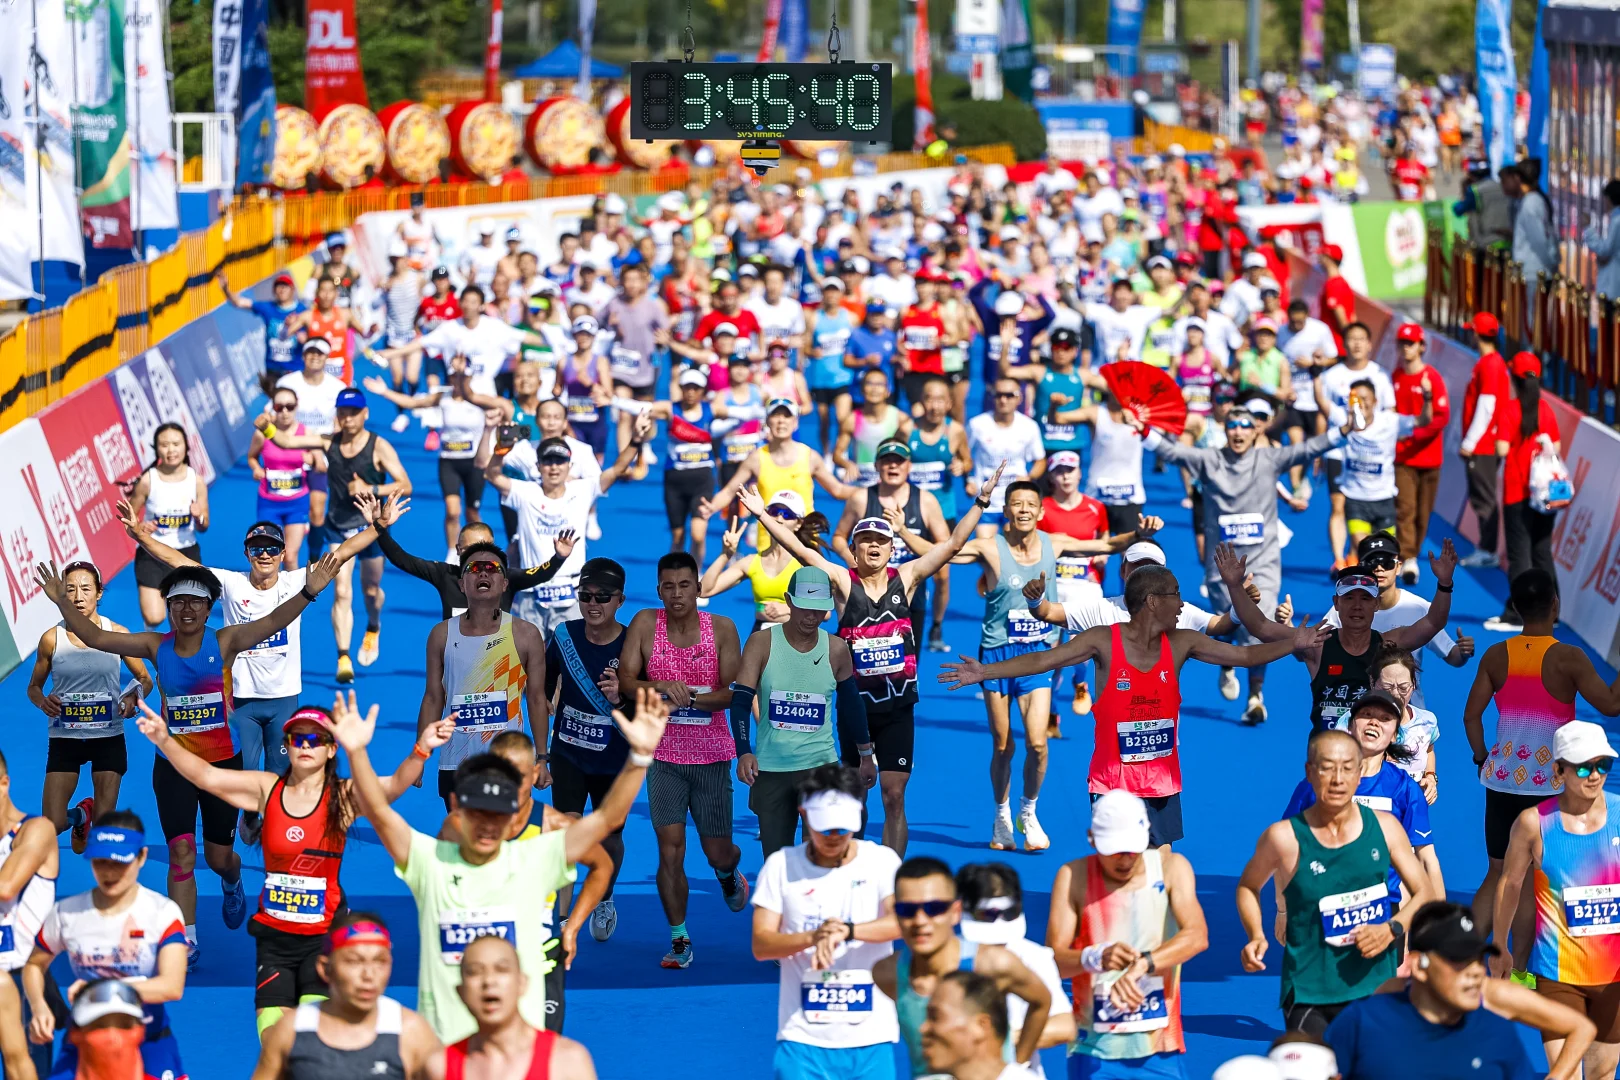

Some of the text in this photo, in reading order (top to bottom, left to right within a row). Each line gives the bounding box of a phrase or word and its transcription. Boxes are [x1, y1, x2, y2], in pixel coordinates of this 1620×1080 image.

[683, 72, 879, 130] 3:45:40
[860, 649, 900, 662] C30051
[563, 639, 613, 714] SUNSET TRAC
[65, 705, 106, 716] B25974
[173, 707, 216, 720] B25297
[457, 706, 501, 719] C31320
[775, 705, 819, 718] B24042
[566, 719, 604, 738] E52683
[1125, 733, 1168, 747] B23693
[269, 889, 318, 907] B25475
[1332, 903, 1384, 929] A12624
[1574, 902, 1620, 918] B2172
[808, 988, 867, 1004] B23504
